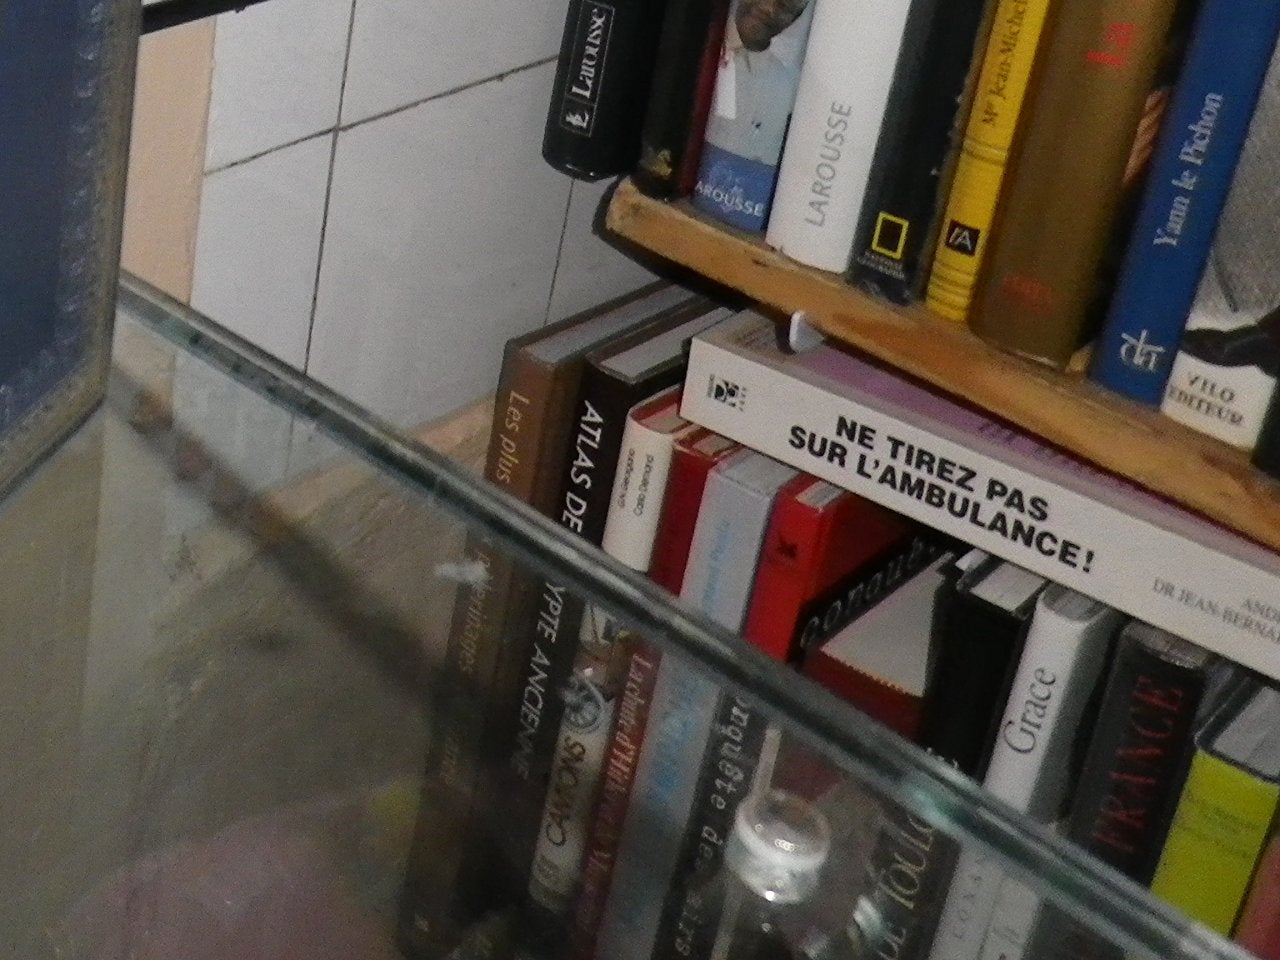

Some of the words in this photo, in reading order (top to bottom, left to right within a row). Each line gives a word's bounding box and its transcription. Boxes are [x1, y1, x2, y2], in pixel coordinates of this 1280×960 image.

[574, 9, 609, 99] Larousse
[989, 0, 1028, 100] Jean-Michel
[1086, 21, 1137, 67] La
[694, 180, 765, 218] AROUSSE
[805, 101, 853, 227] LAROUSSE
[1153, 195, 1191, 247] Yann
[1178, 92, 1225, 166] Pichon
[508, 391, 530, 433] Les
[1186, 370, 1236, 404] VILO
[496, 433, 520, 485] plus
[570, 400, 604, 490] ATLAS
[788, 426, 848, 470] SUR
[835, 415, 876, 450] NE
[888, 434, 977, 492] TIREZ
[986, 478, 1049, 523] PAS
[562, 491, 590, 534] DE
[536, 582, 567, 644] YPTE
[710, 695, 753, 810] nquête
[1004, 666, 1057, 755] Grace
[1091, 674, 1184, 853] FRANCE
